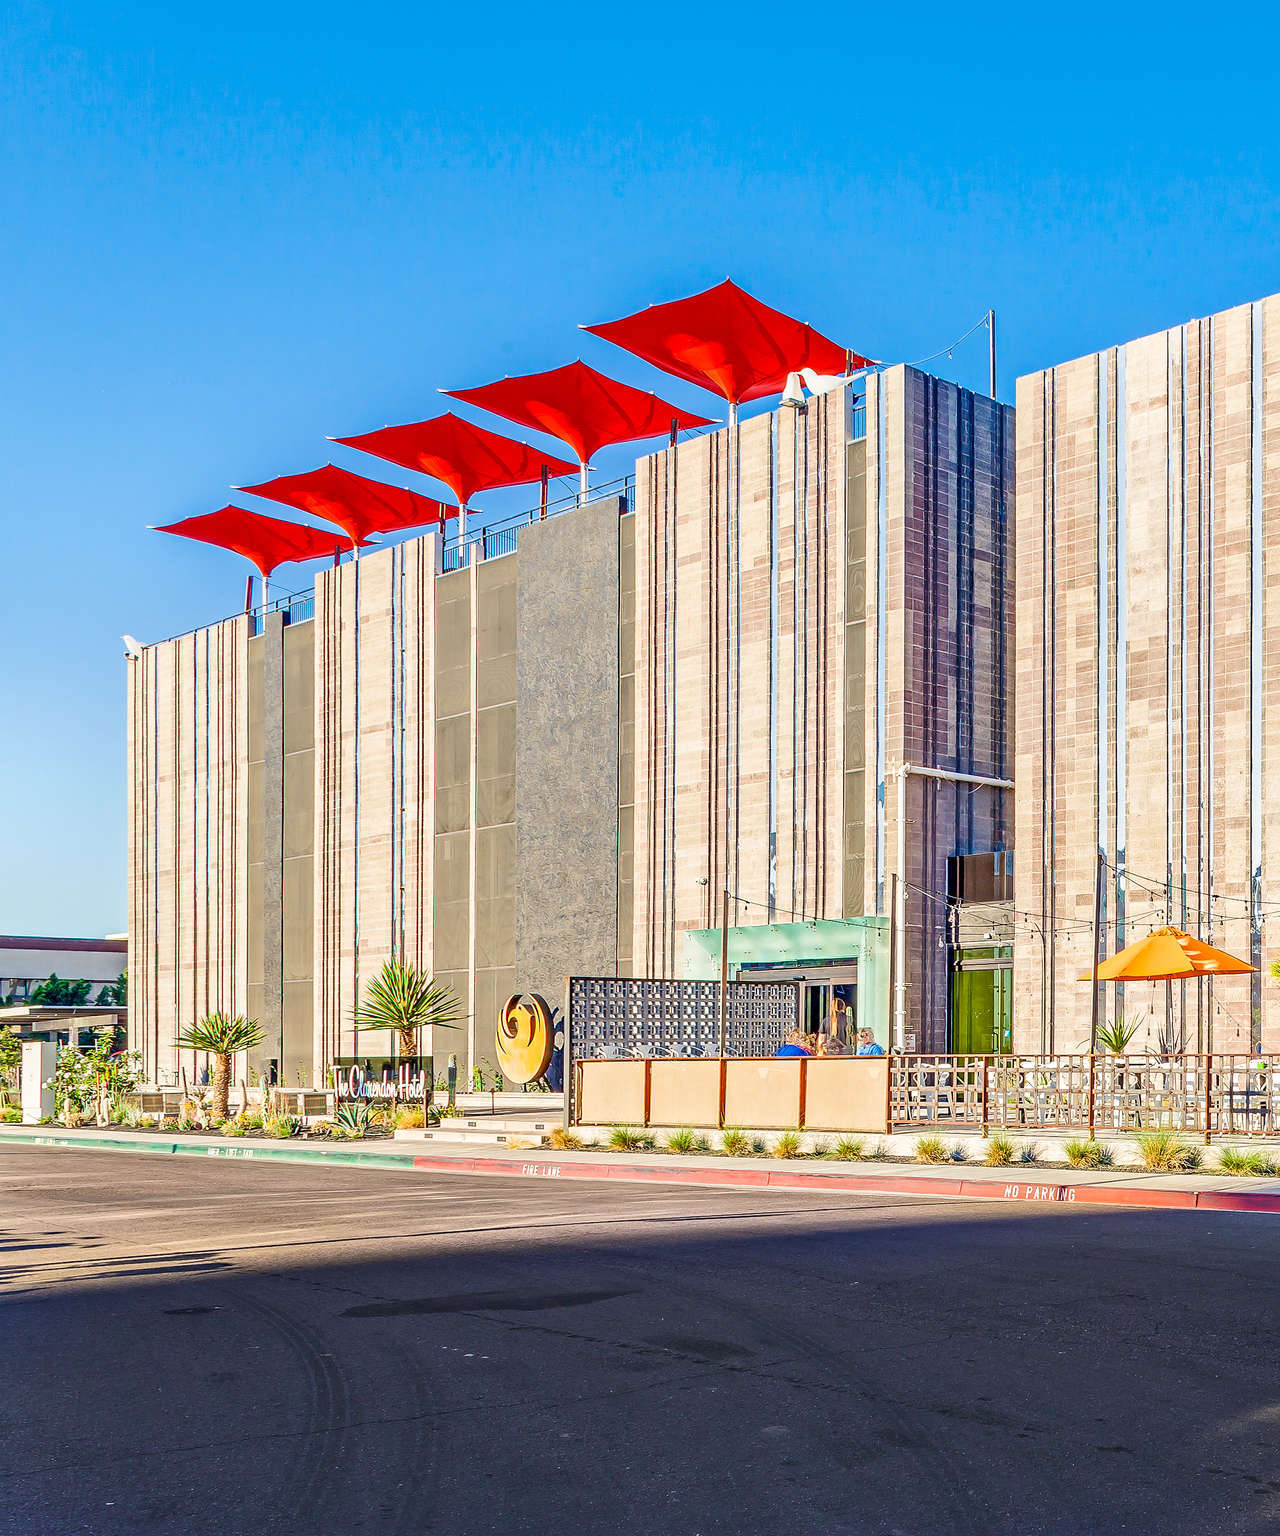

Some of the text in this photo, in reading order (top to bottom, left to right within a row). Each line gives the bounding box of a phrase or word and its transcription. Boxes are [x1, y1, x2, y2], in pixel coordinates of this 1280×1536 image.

[329, 1063, 426, 1101] The Clarendon Hotel
[522, 1163, 561, 1177] FIRE LANE
[1004, 1184, 1076, 1201] NO PARKING
